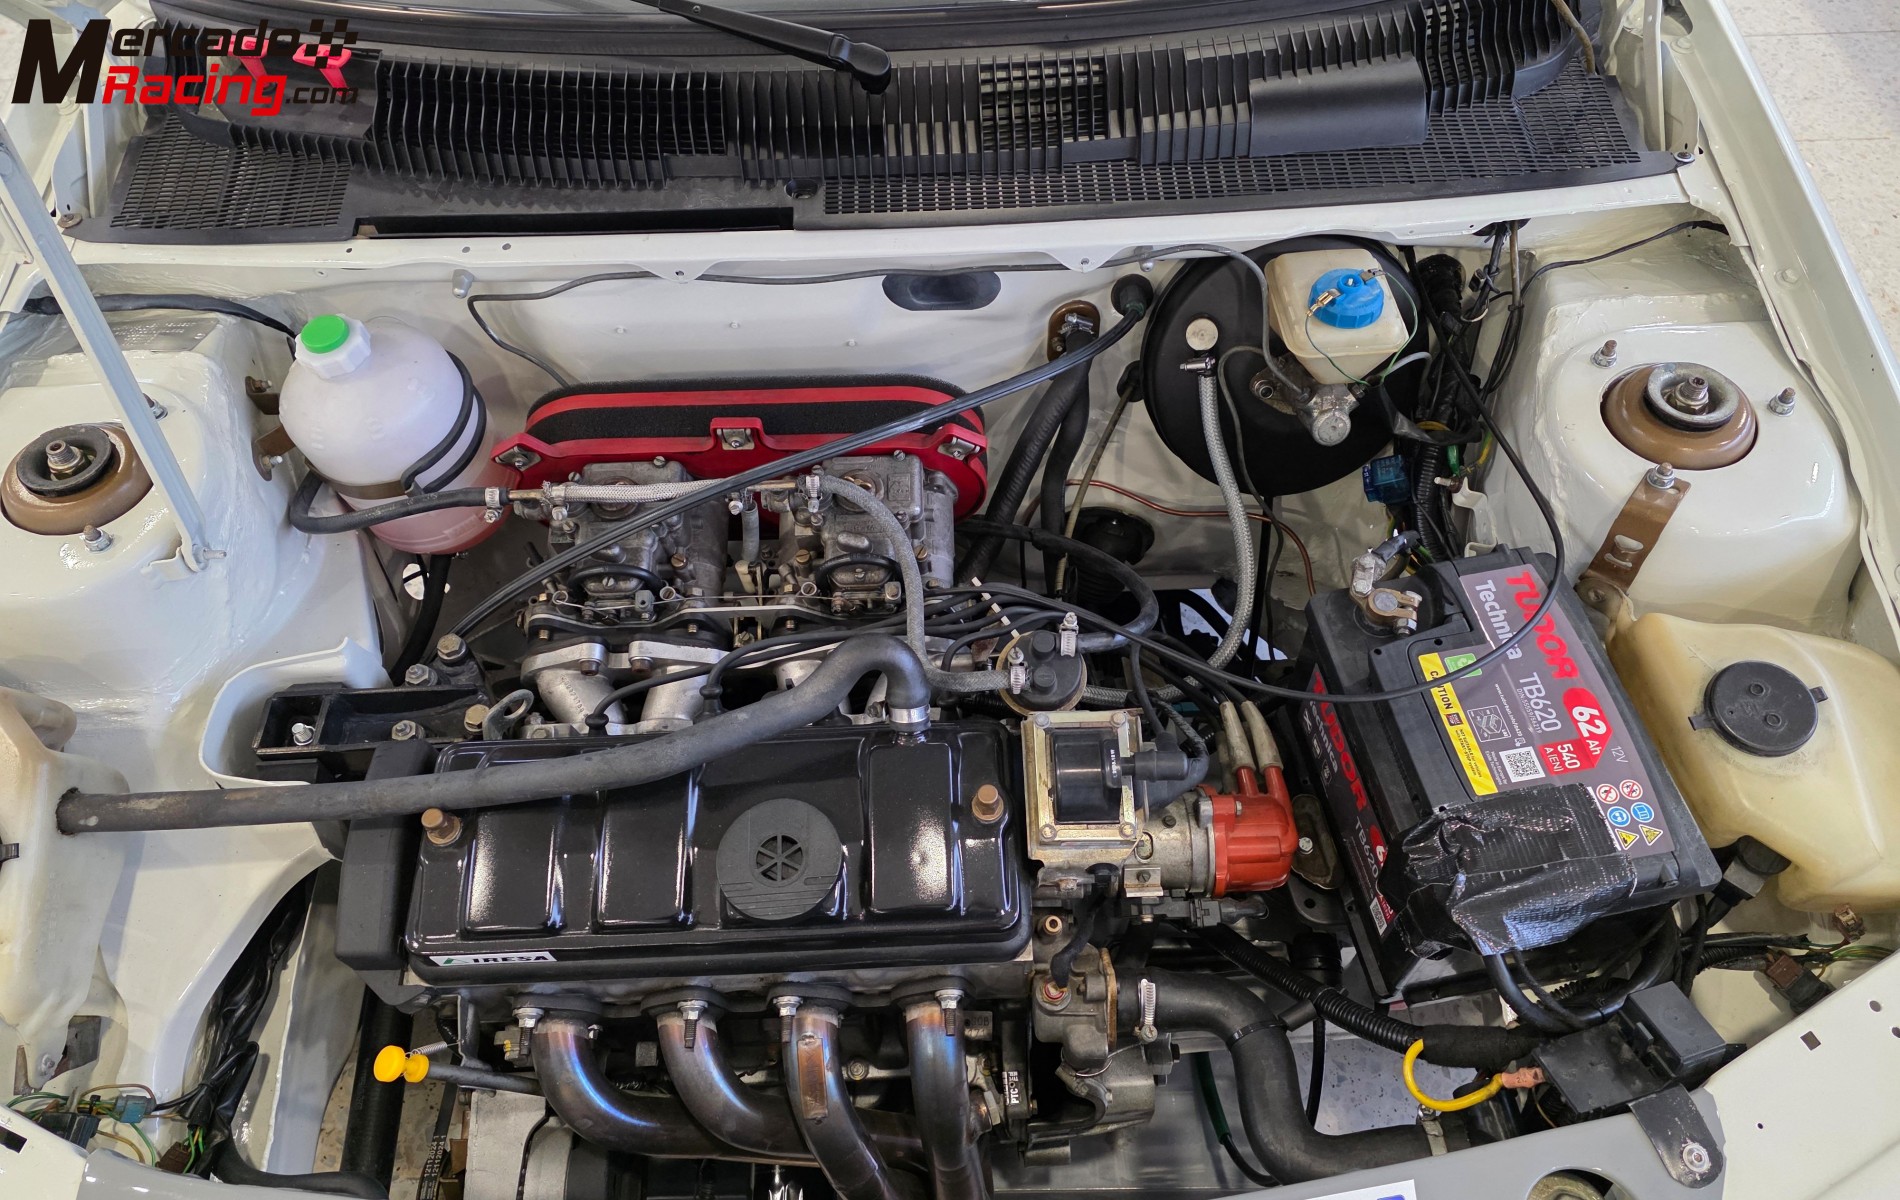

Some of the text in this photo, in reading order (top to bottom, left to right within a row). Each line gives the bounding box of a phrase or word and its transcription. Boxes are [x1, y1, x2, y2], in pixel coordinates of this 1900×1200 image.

[1430, 670, 1454, 710] CTION
[1519, 671, 1562, 732] TB620
[1309, 701, 1338, 774] echnica
[1572, 706, 1607, 755] 62 Ah
[1547, 754, 1564, 772] (EN)
[1557, 743, 1581, 769] 540
[1611, 745, 1629, 763] 12V
[1355, 815, 1379, 878] TB620
